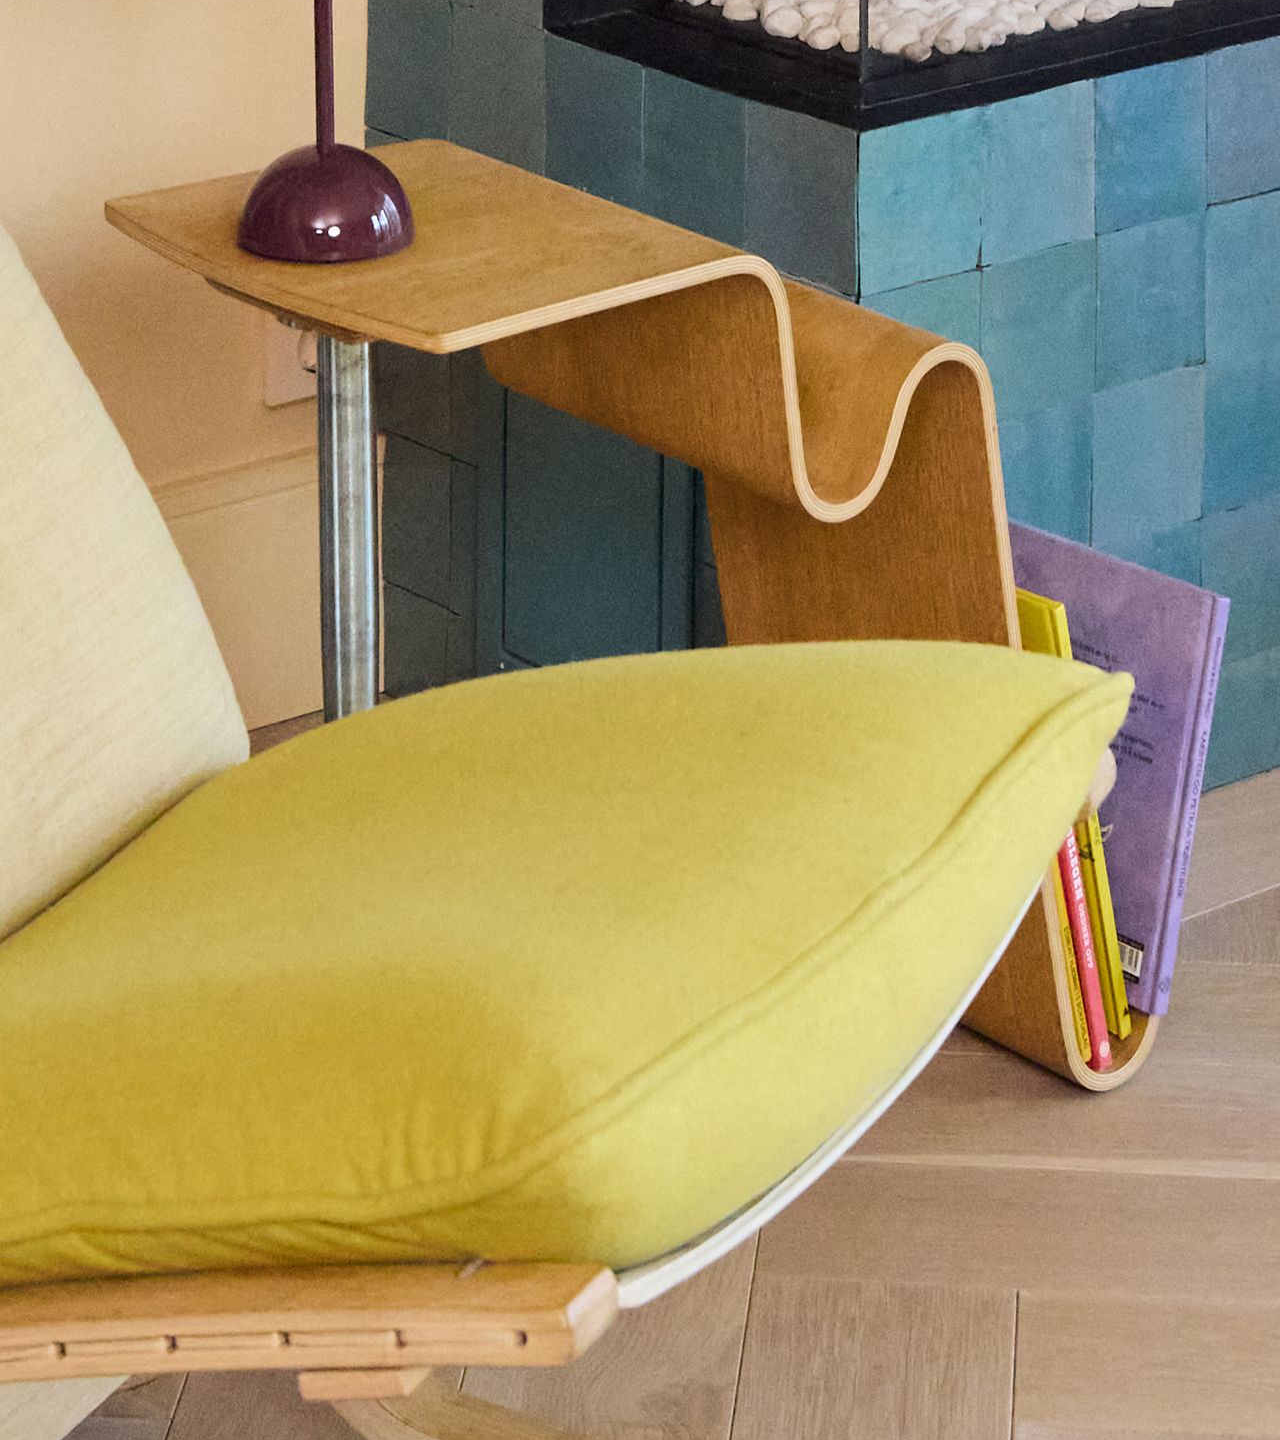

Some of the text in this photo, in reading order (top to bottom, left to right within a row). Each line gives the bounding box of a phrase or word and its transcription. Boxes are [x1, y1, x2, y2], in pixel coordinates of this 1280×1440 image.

[1194, 730, 1208, 777] KARSTEN
[1192, 778, 1201, 795] OG
[1185, 797, 1198, 838] PETRAS
[1078, 903, 1089, 947] ORDNER
[1085, 948, 1093, 969] OPP
